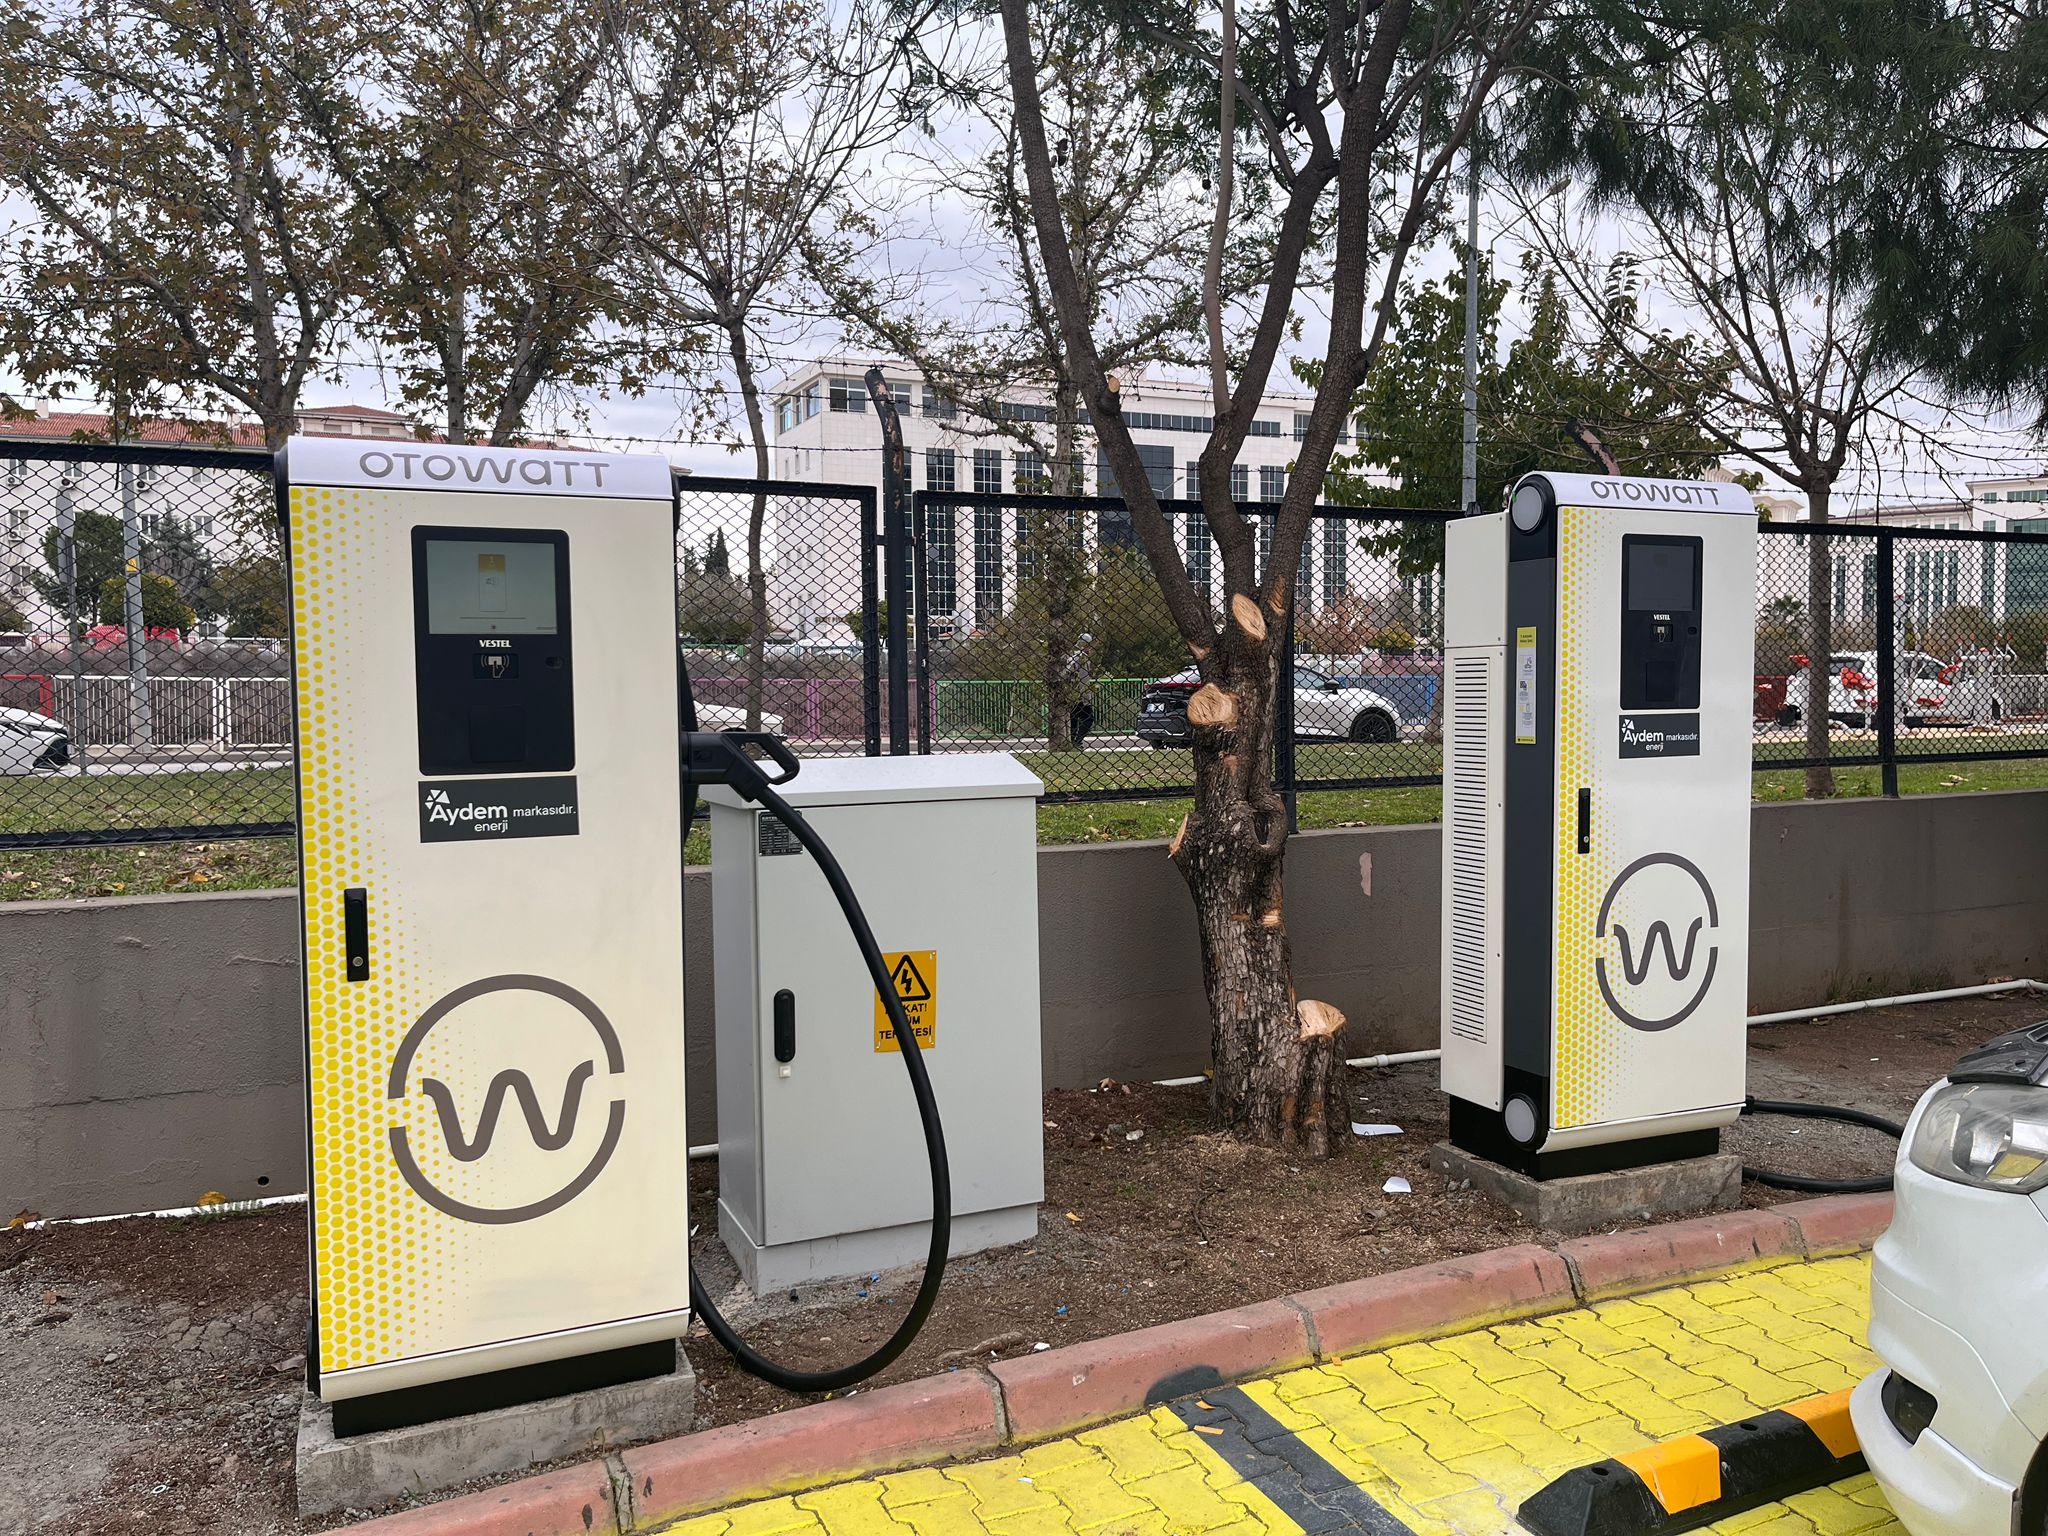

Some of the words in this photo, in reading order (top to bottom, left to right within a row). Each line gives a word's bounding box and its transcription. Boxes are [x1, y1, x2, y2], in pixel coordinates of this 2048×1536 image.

[479, 639, 512, 648] VESTEL
[1622, 729, 1664, 746] Aydem
[1645, 742, 1664, 752] enerji
[429, 803, 508, 826] Aydem
[512, 804, 577, 818] markasıdır.
[474, 820, 509, 834] enerji
